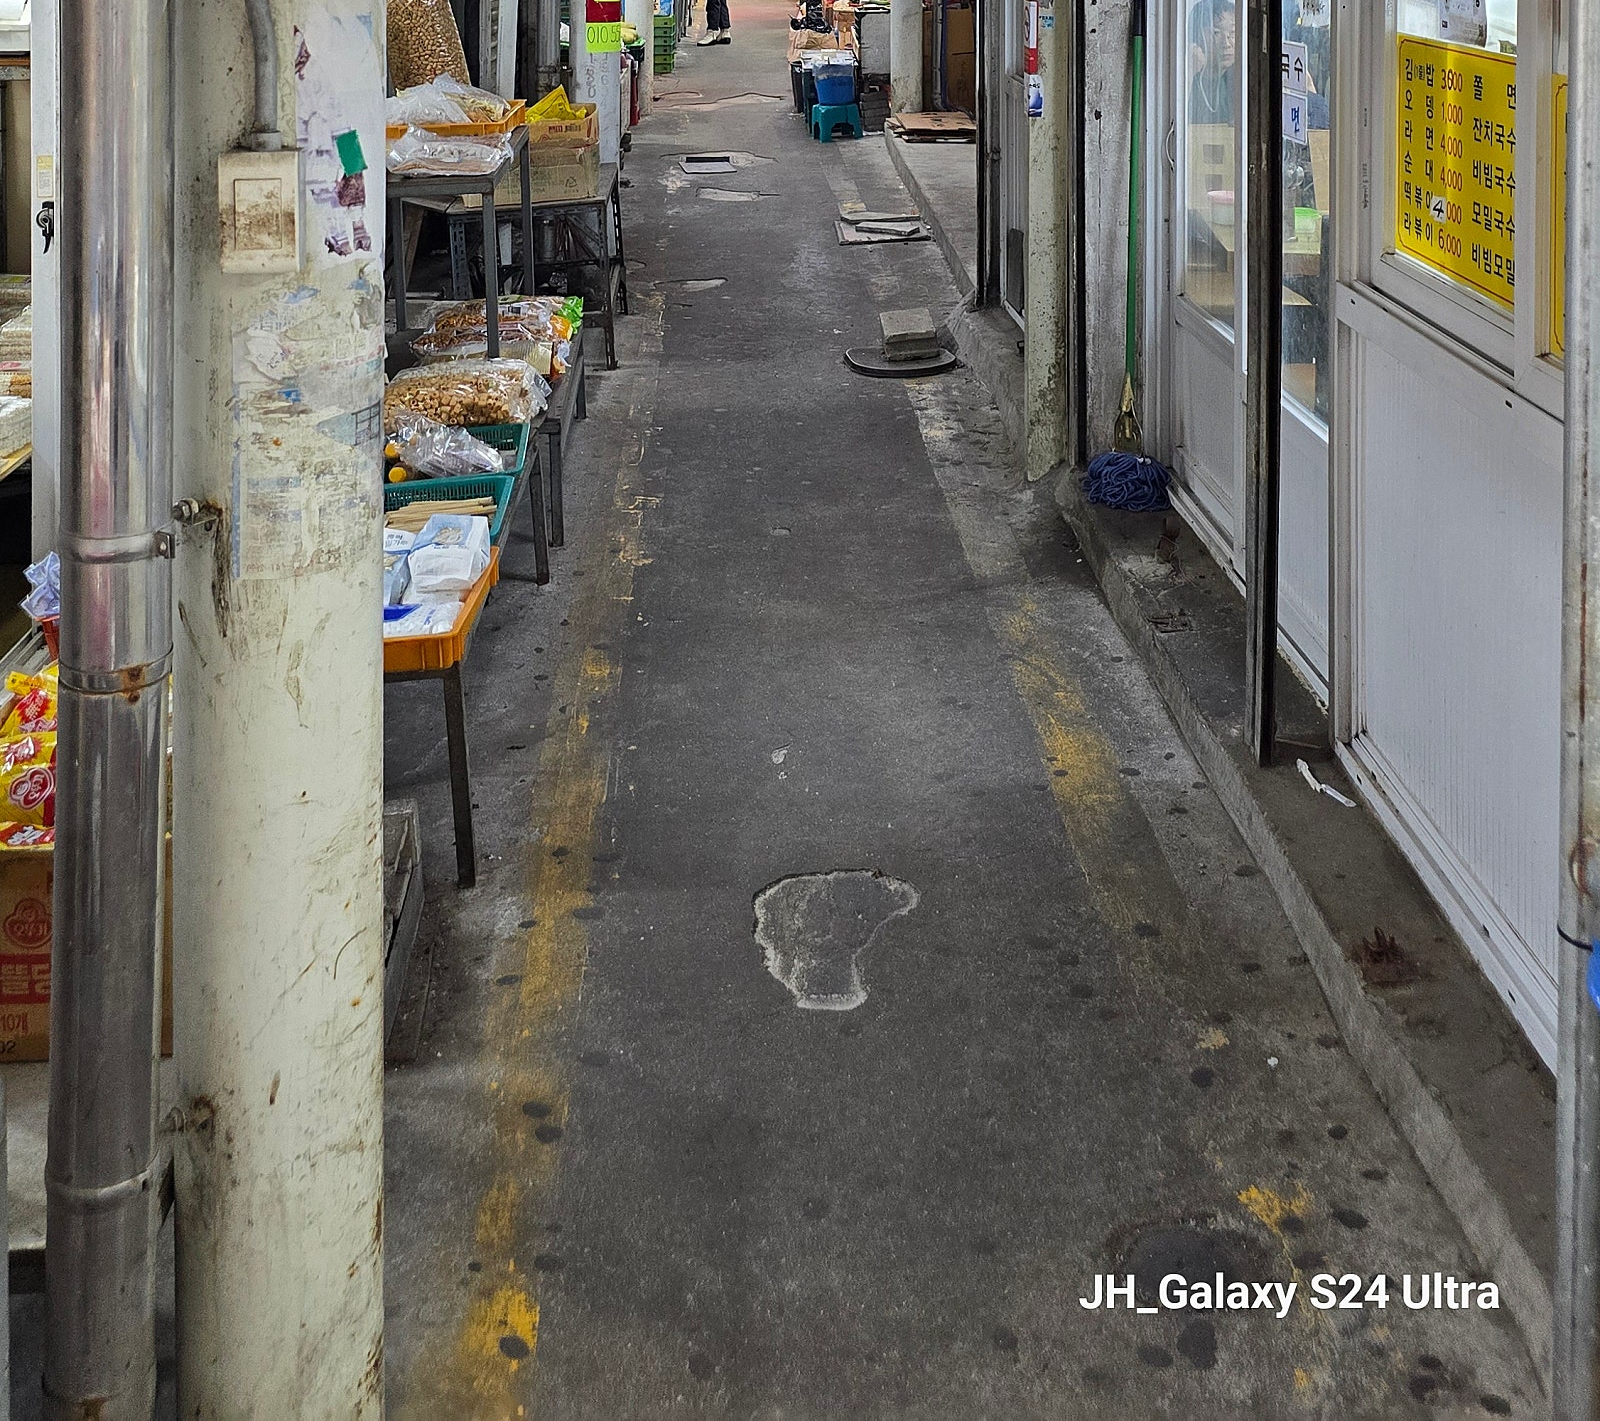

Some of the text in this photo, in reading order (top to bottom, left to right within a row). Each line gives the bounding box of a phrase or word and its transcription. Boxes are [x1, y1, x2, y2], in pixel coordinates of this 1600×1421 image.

[1441, 101, 1463, 125] 1,000
[1440, 133, 1463, 159] 4,000
[1473, 117, 1516, 154] 잔치국수
[1440, 165, 1462, 191] 4,000
[1473, 159, 1516, 197] 비빔국수
[1472, 201, 1515, 241] 모밀국수
[1438, 228, 1462, 258] 6,000
[1471, 242, 1515, 287] 비빔모밀
